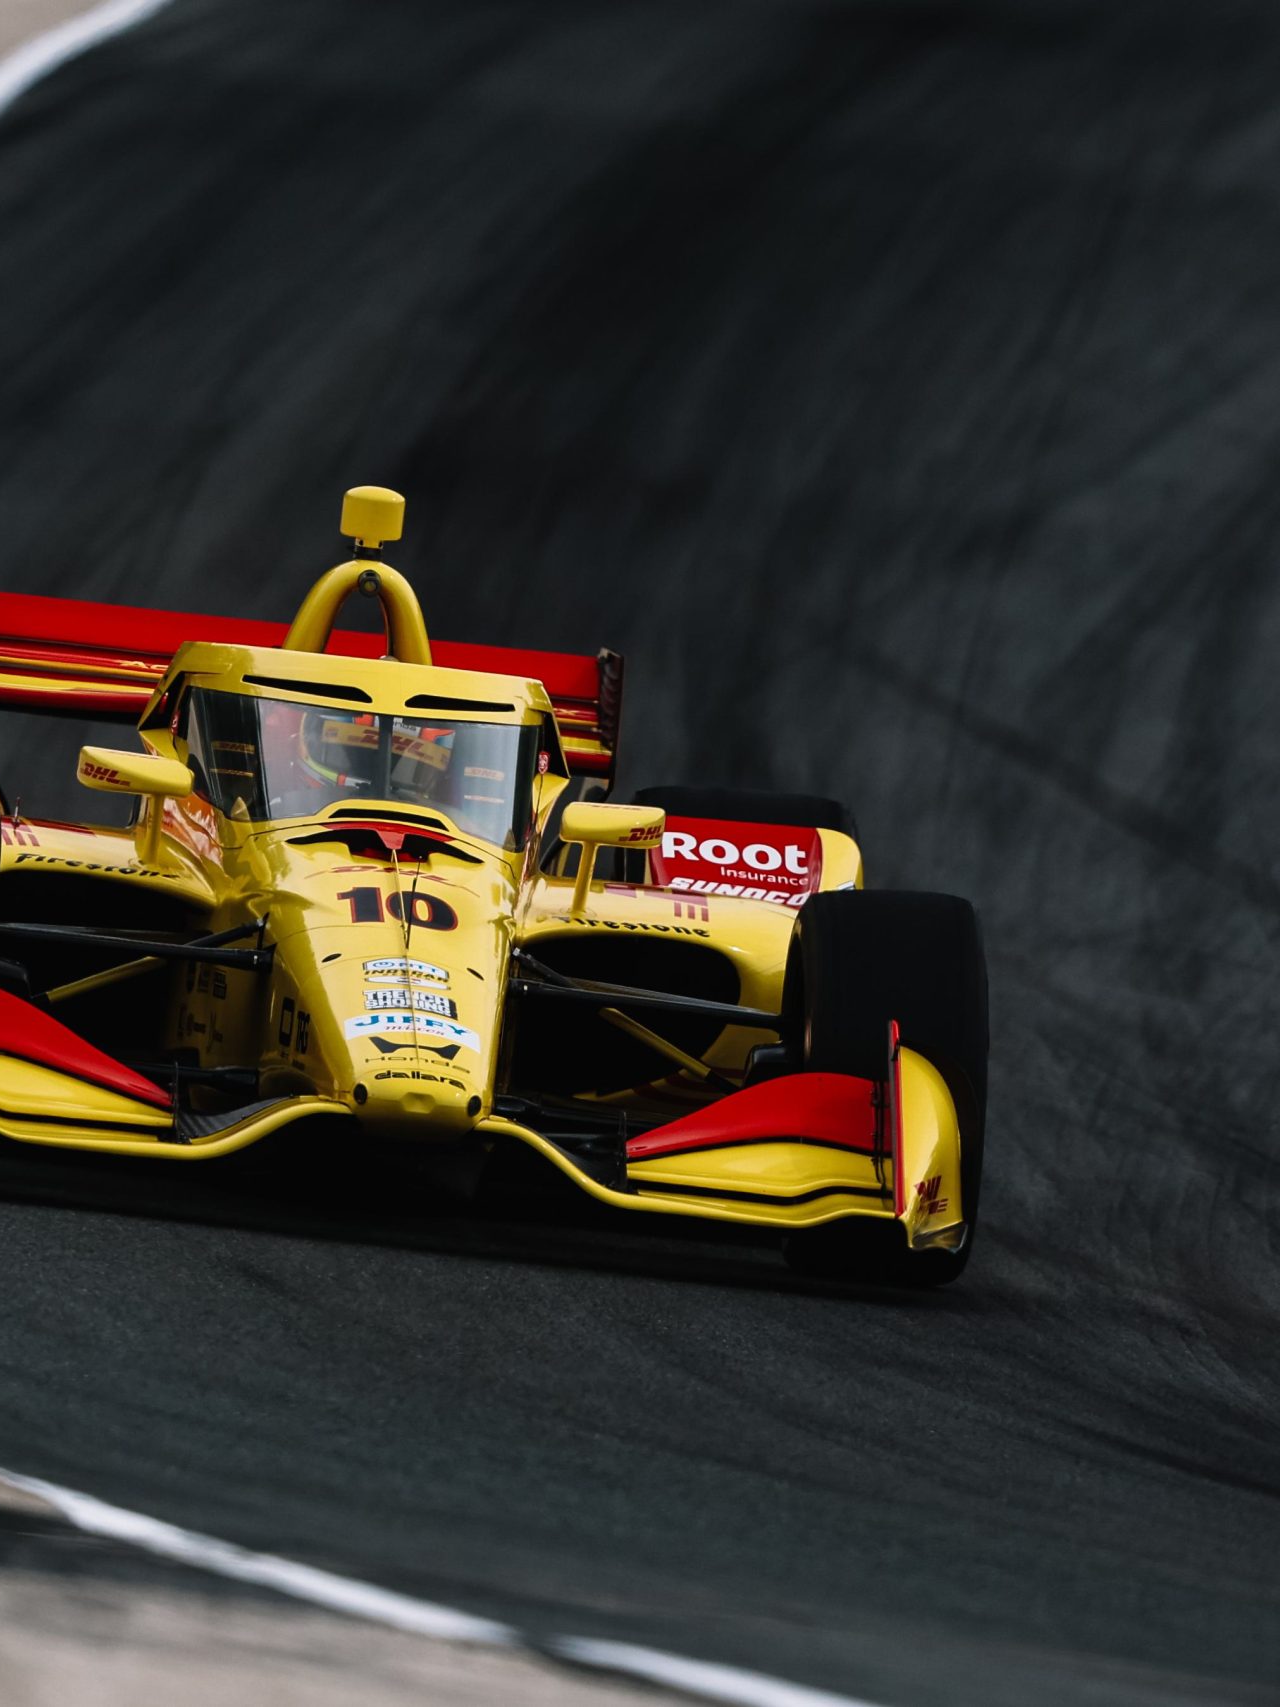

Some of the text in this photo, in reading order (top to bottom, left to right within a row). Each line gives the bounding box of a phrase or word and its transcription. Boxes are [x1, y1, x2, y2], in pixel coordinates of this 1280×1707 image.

[83, 762, 120, 785] DHL
[661, 831, 809, 876] Root
[14, 852, 181, 880] Firestone
[720, 866, 810, 887] Insurance
[670, 877, 811, 907] SUNOCO
[336, 886, 459, 931] 10
[551, 915, 710, 938] Firestone
[363, 968, 449, 983] INDYCAR
[353, 1014, 468, 1036] JIFFY
[364, 1055, 470, 1074] Honda
[373, 1069, 467, 1091] dallara
